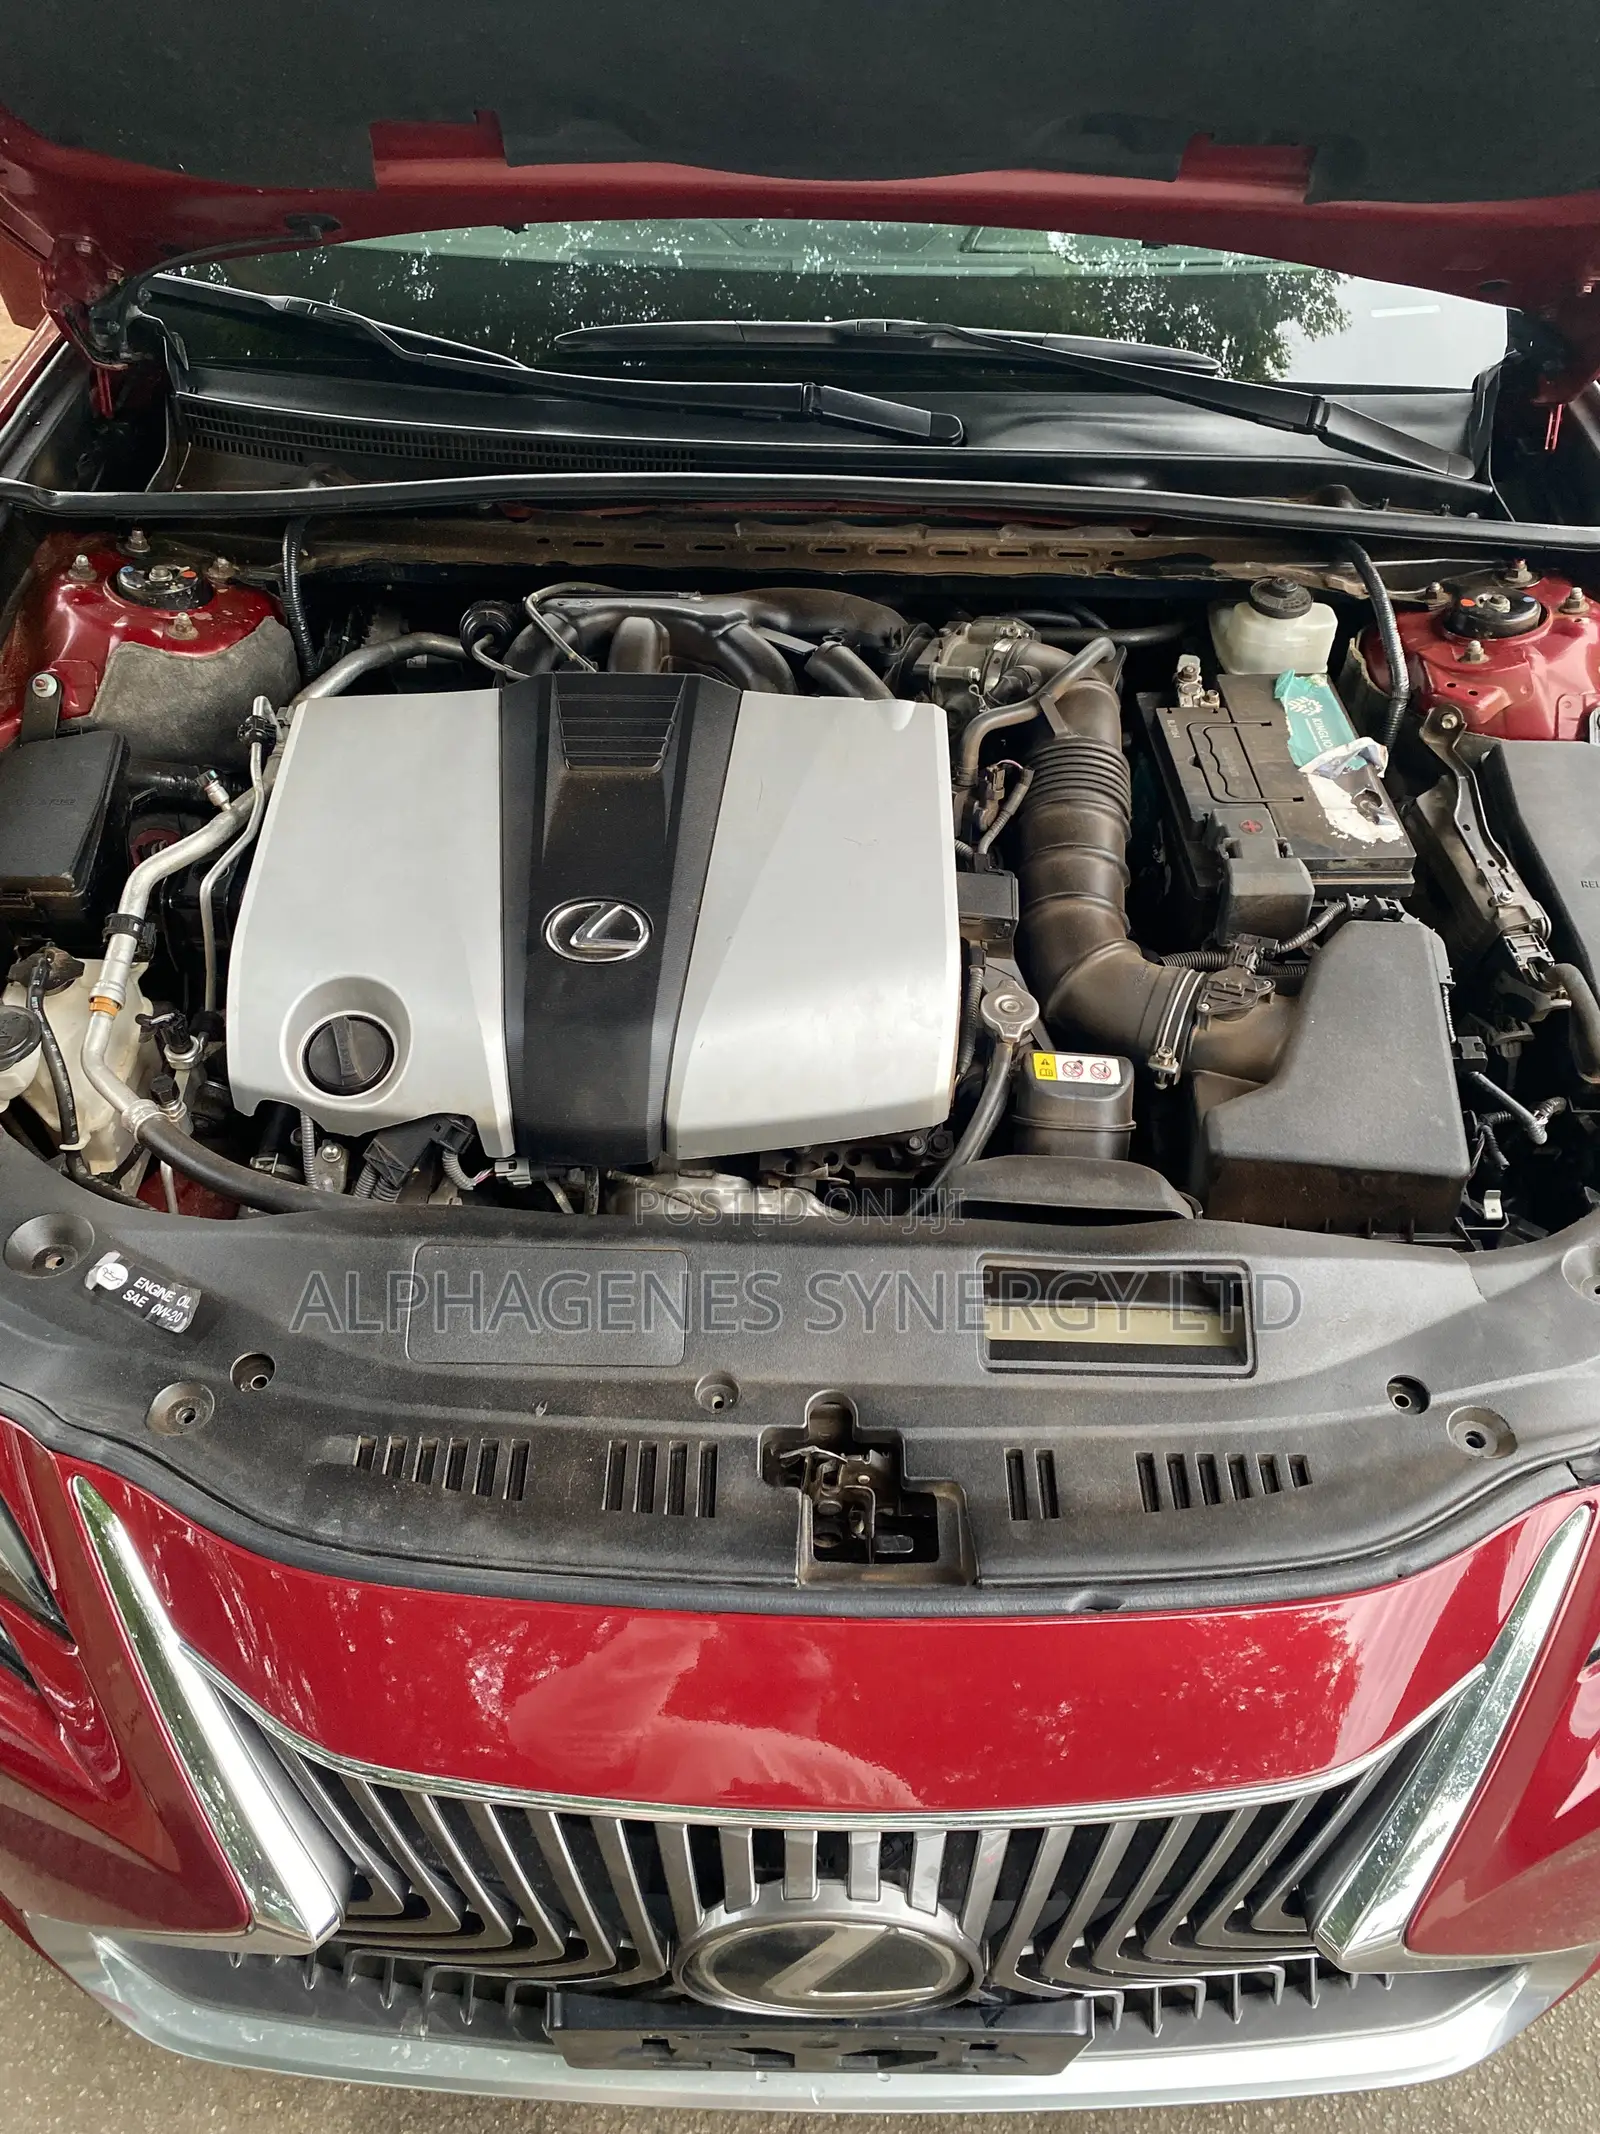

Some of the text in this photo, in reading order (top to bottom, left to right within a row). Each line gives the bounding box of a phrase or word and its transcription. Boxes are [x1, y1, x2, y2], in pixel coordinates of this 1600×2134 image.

[1311, 717, 1335, 749] KINGLIO
[122, 1290, 184, 1323] SAE 0W-20
[133, 1276, 192, 1309] ENGINE OIL
